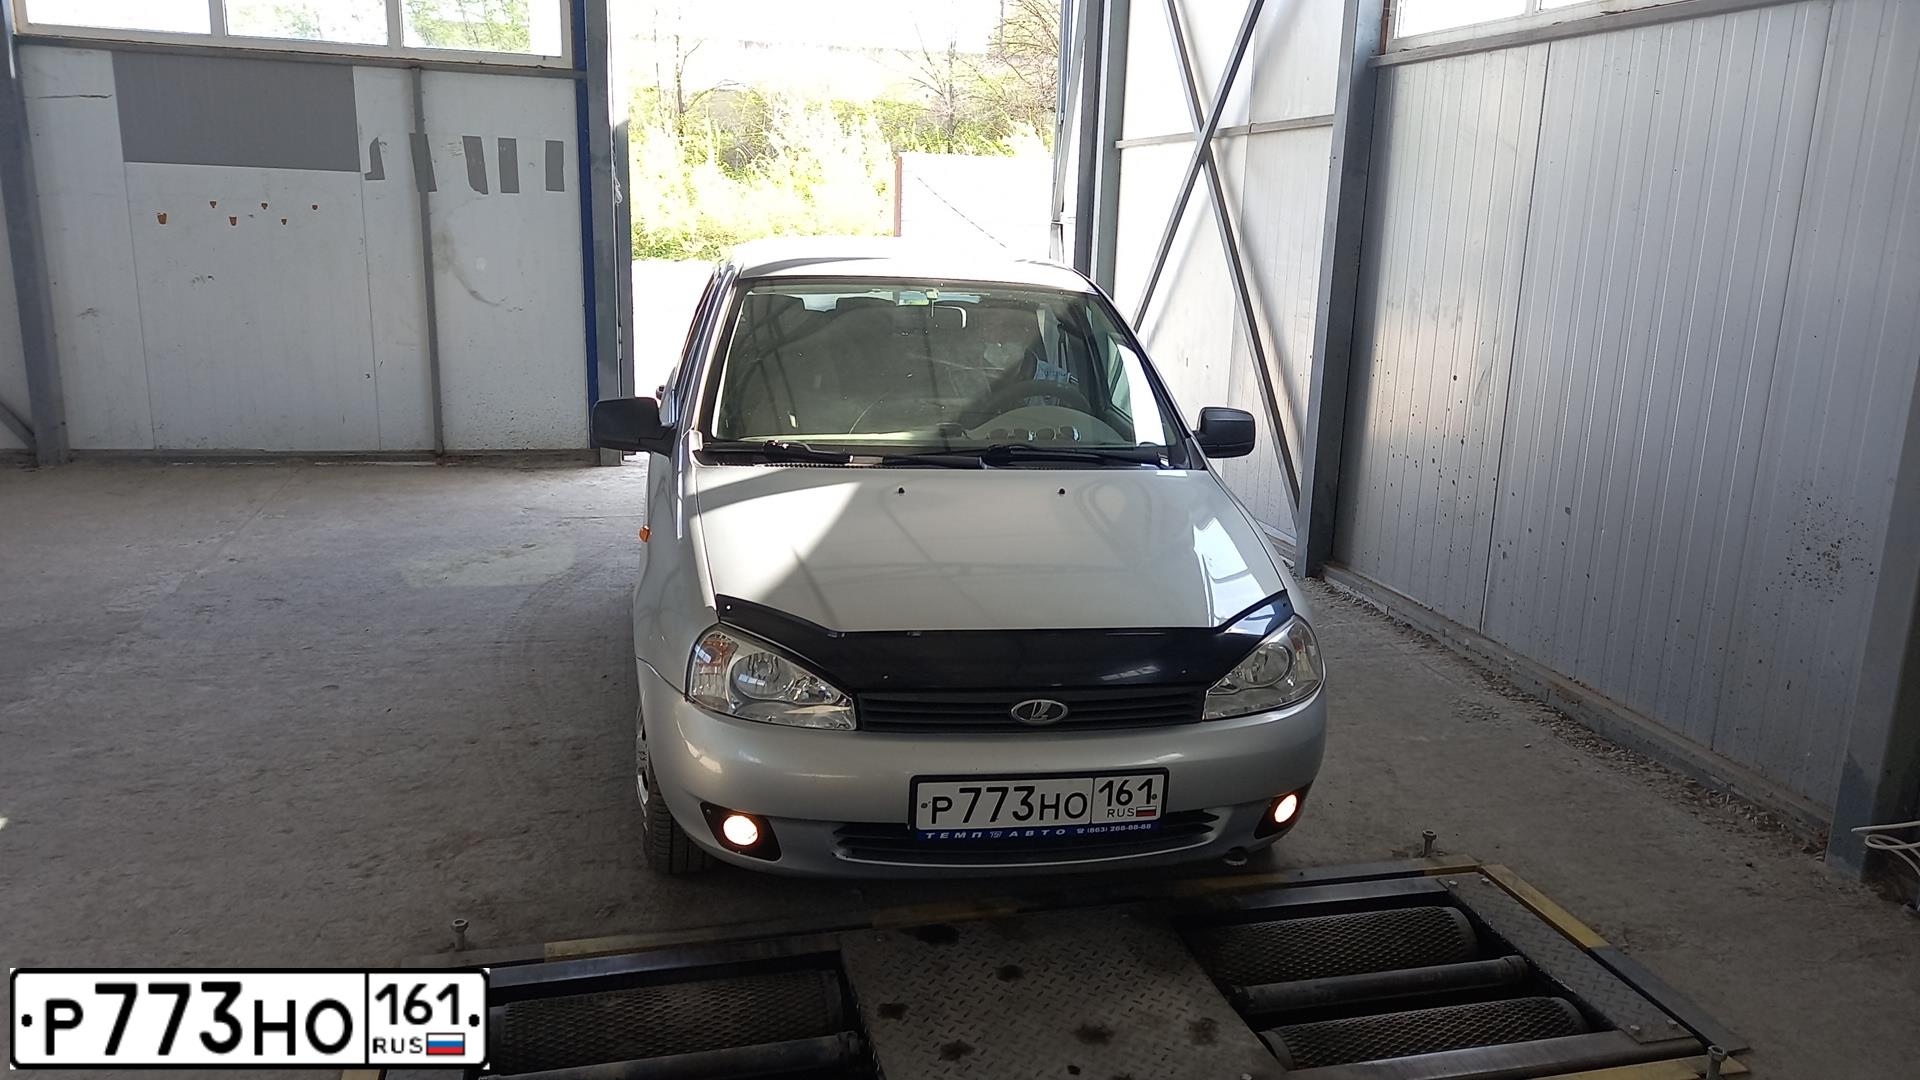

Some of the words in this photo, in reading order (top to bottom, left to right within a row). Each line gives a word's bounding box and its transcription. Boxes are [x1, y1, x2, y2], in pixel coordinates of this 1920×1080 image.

[1098, 778, 1153, 807] 161
[1106, 808, 1135, 818] RUS
[1008, 828, 1066, 837] АВТО
